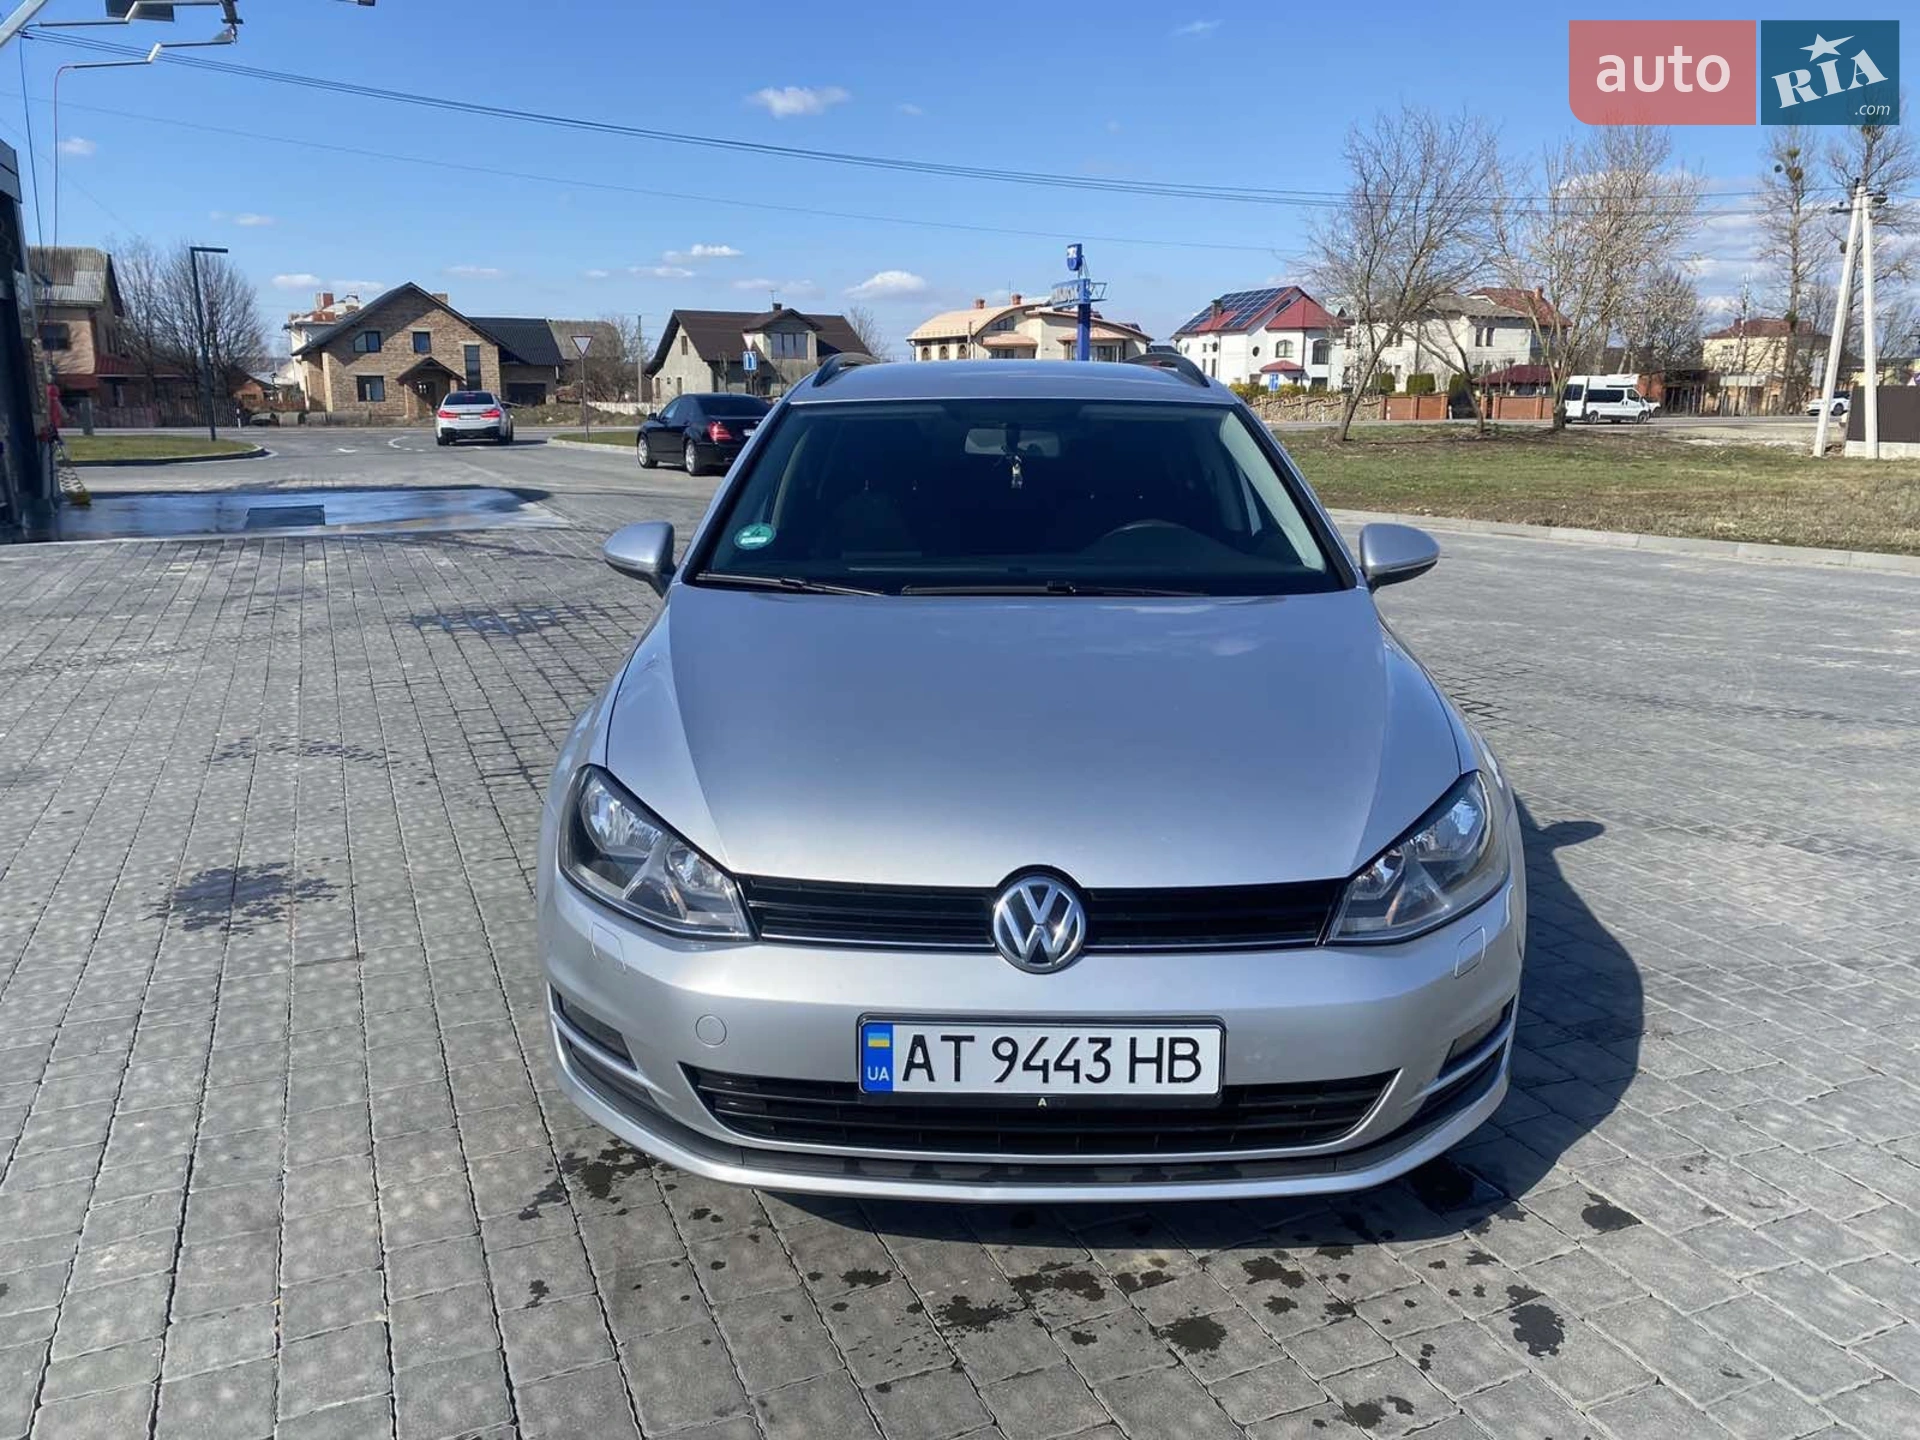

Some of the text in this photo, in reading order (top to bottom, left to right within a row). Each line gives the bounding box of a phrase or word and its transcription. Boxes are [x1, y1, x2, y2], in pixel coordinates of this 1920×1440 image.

[867, 1066, 890, 1082] UA
[902, 1034, 1202, 1084] AT 9443 HB
